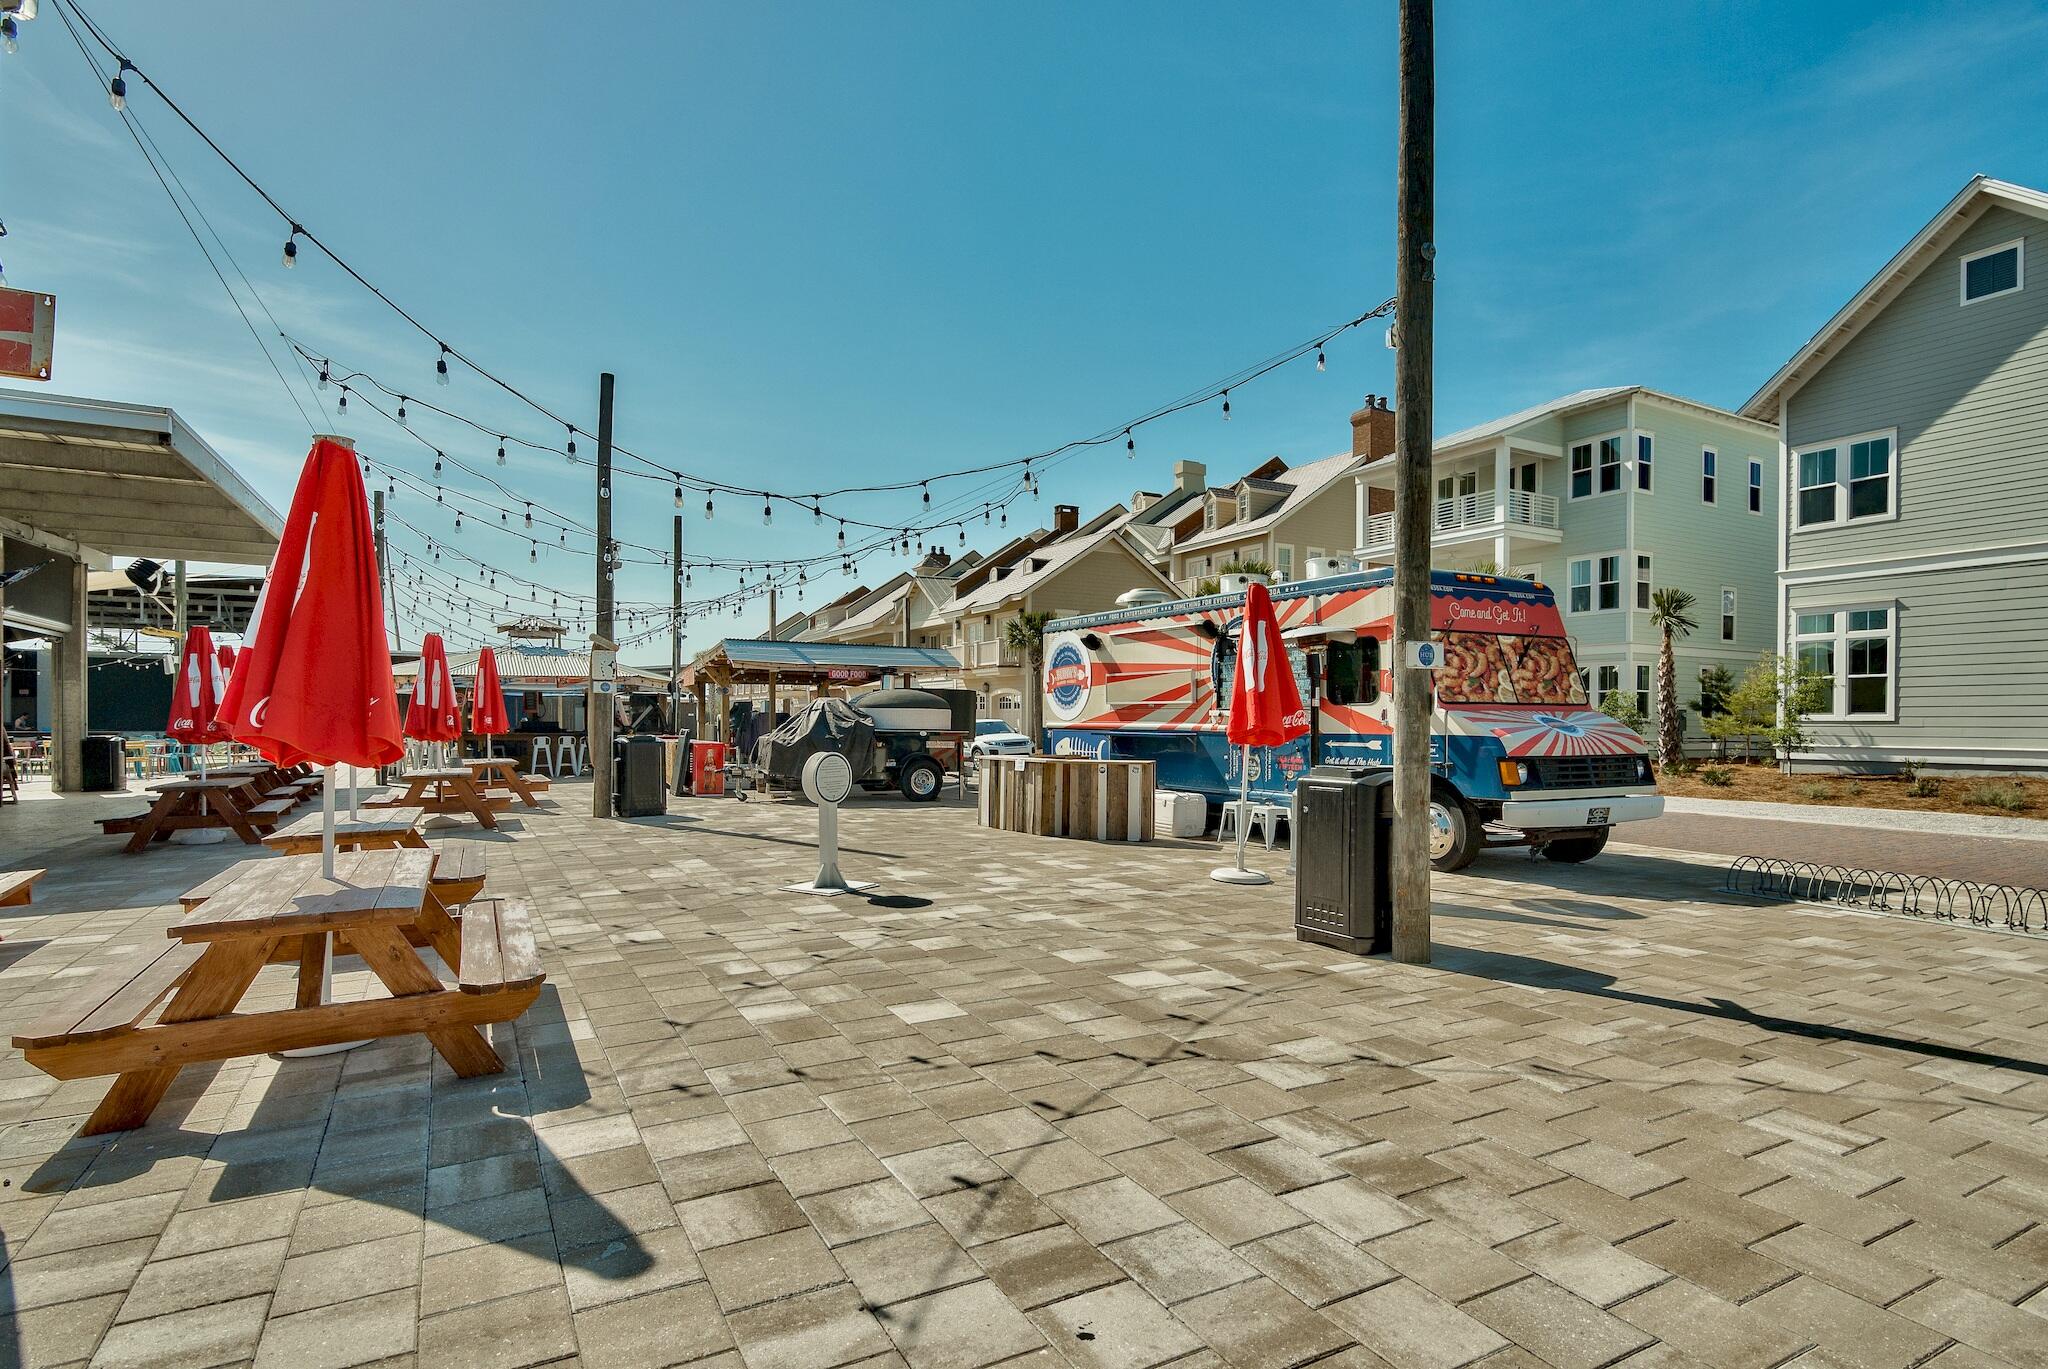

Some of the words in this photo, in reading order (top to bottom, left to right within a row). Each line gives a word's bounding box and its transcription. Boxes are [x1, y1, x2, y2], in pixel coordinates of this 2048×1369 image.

[1172, 600, 1200, 610] SOMETHING
[1201, 598, 1212, 607] FOR
[1213, 595, 1241, 605] EVERYONE
[1124, 607, 1159, 618] ENTERTAINMENT
[1449, 602, 1476, 620] Come
[1476, 607, 1492, 619] and
[1492, 606, 1510, 624] Get
[1511, 607, 1526, 622] It!
[831, 670, 849, 678] GOOD
[850, 670, 867, 678] FOOD
[1324, 755, 1335, 765] Get
[1339, 756, 1350, 765] all
[1356, 757, 1367, 766] The
